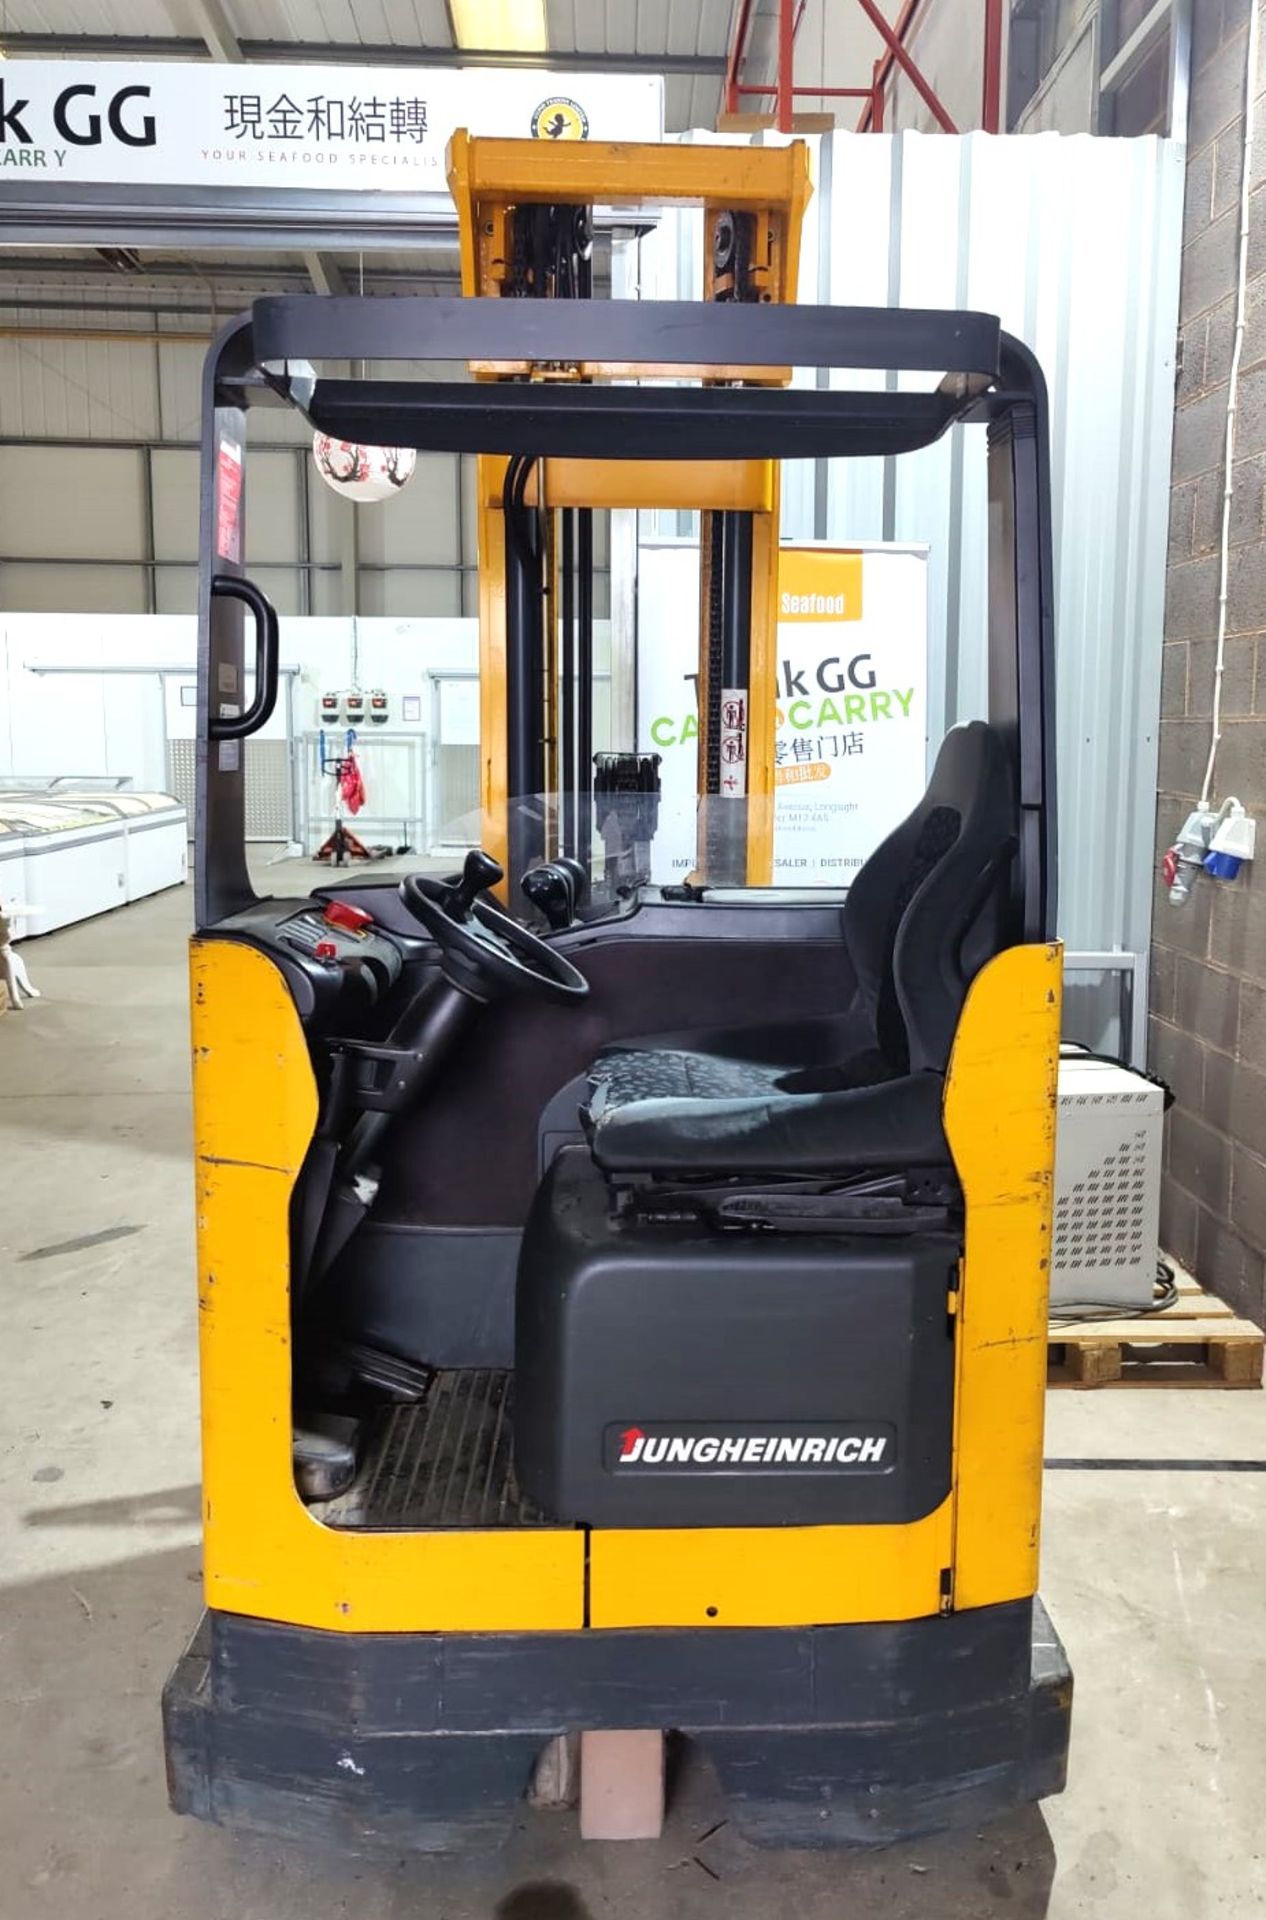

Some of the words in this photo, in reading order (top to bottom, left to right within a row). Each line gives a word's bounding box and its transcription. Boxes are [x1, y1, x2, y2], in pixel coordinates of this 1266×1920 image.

[53, 84, 156, 147] GG
[223, 93, 428, 144] 現金和結轉
[0, 149, 66, 167] ARRY
[201, 149, 247, 161] YOUR
[257, 150, 338, 164] SEAFOOD
[350, 153, 438, 166] SPECIALIS
[781, 592, 844, 614] Seafood
[816, 653, 876, 693] GG
[788, 687, 915, 730] CARRY
[619, 1426, 887, 1463] JUNGHEINRICH
